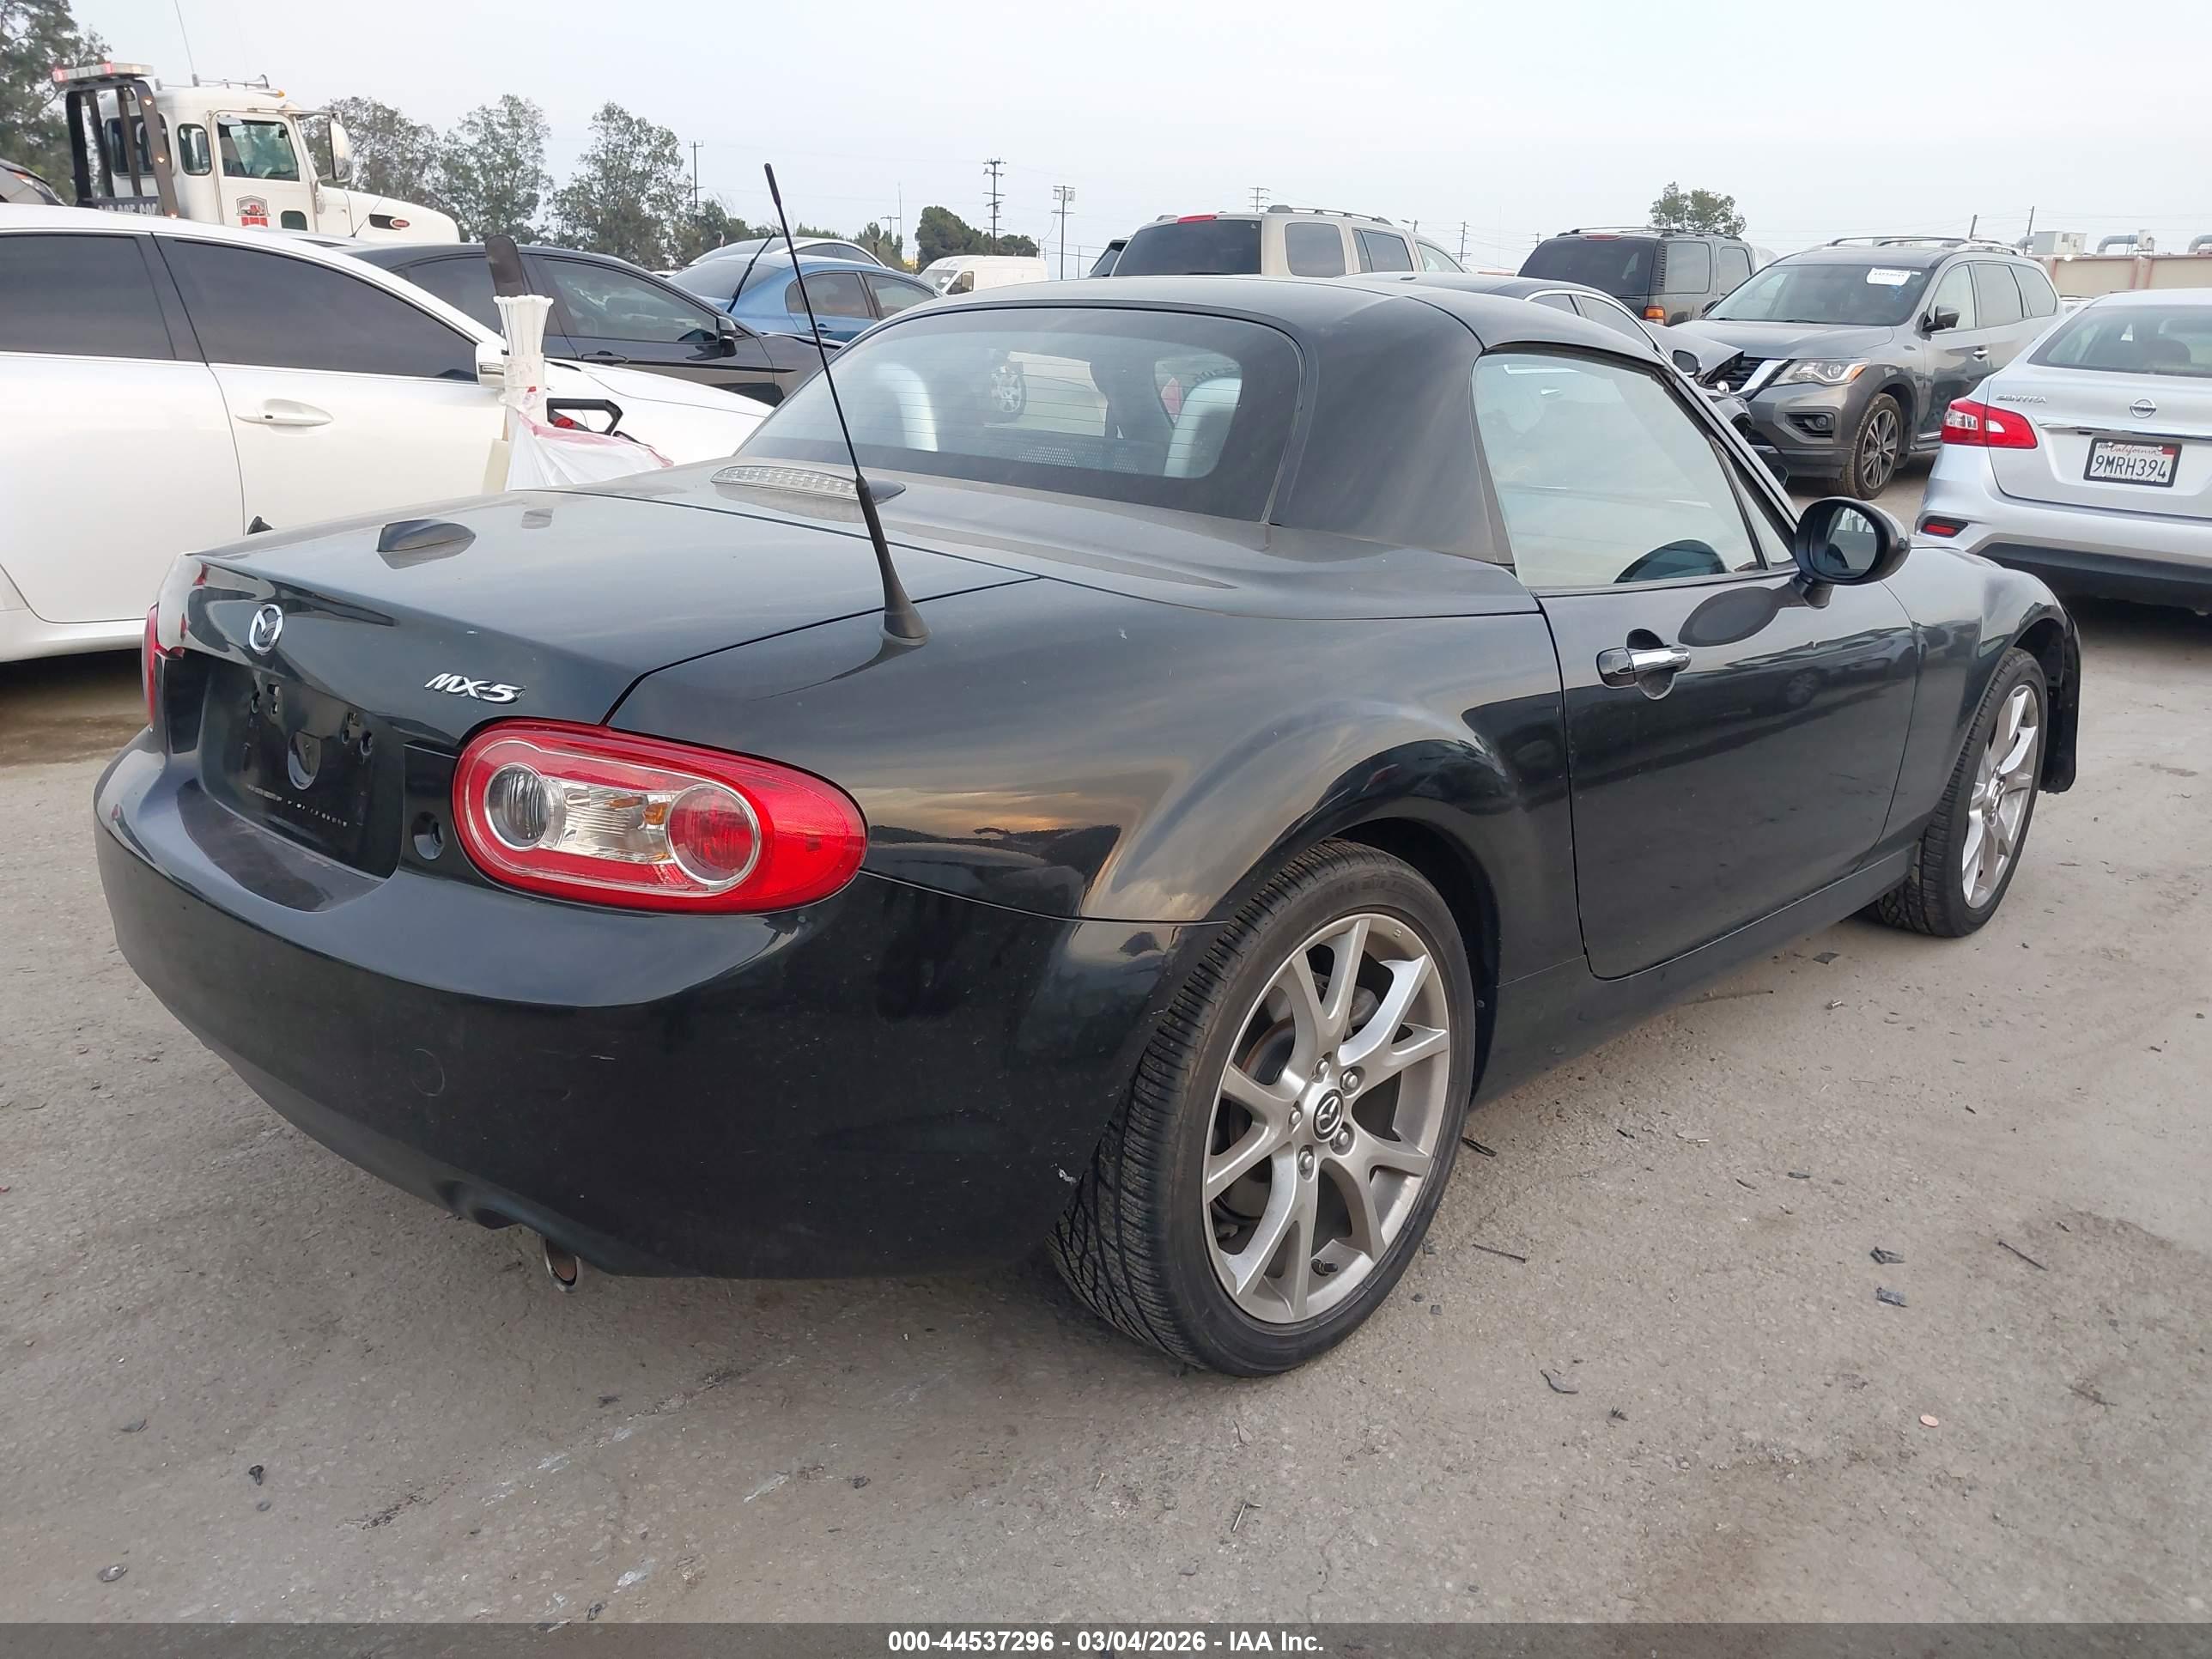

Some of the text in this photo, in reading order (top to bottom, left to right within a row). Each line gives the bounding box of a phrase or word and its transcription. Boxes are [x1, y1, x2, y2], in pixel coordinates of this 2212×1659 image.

[1996, 394, 2047, 404] SENTRA
[2110, 444, 2160, 456] California
[2093, 454, 2166, 479] 9MRH394
[424, 672, 524, 704] MX-5
